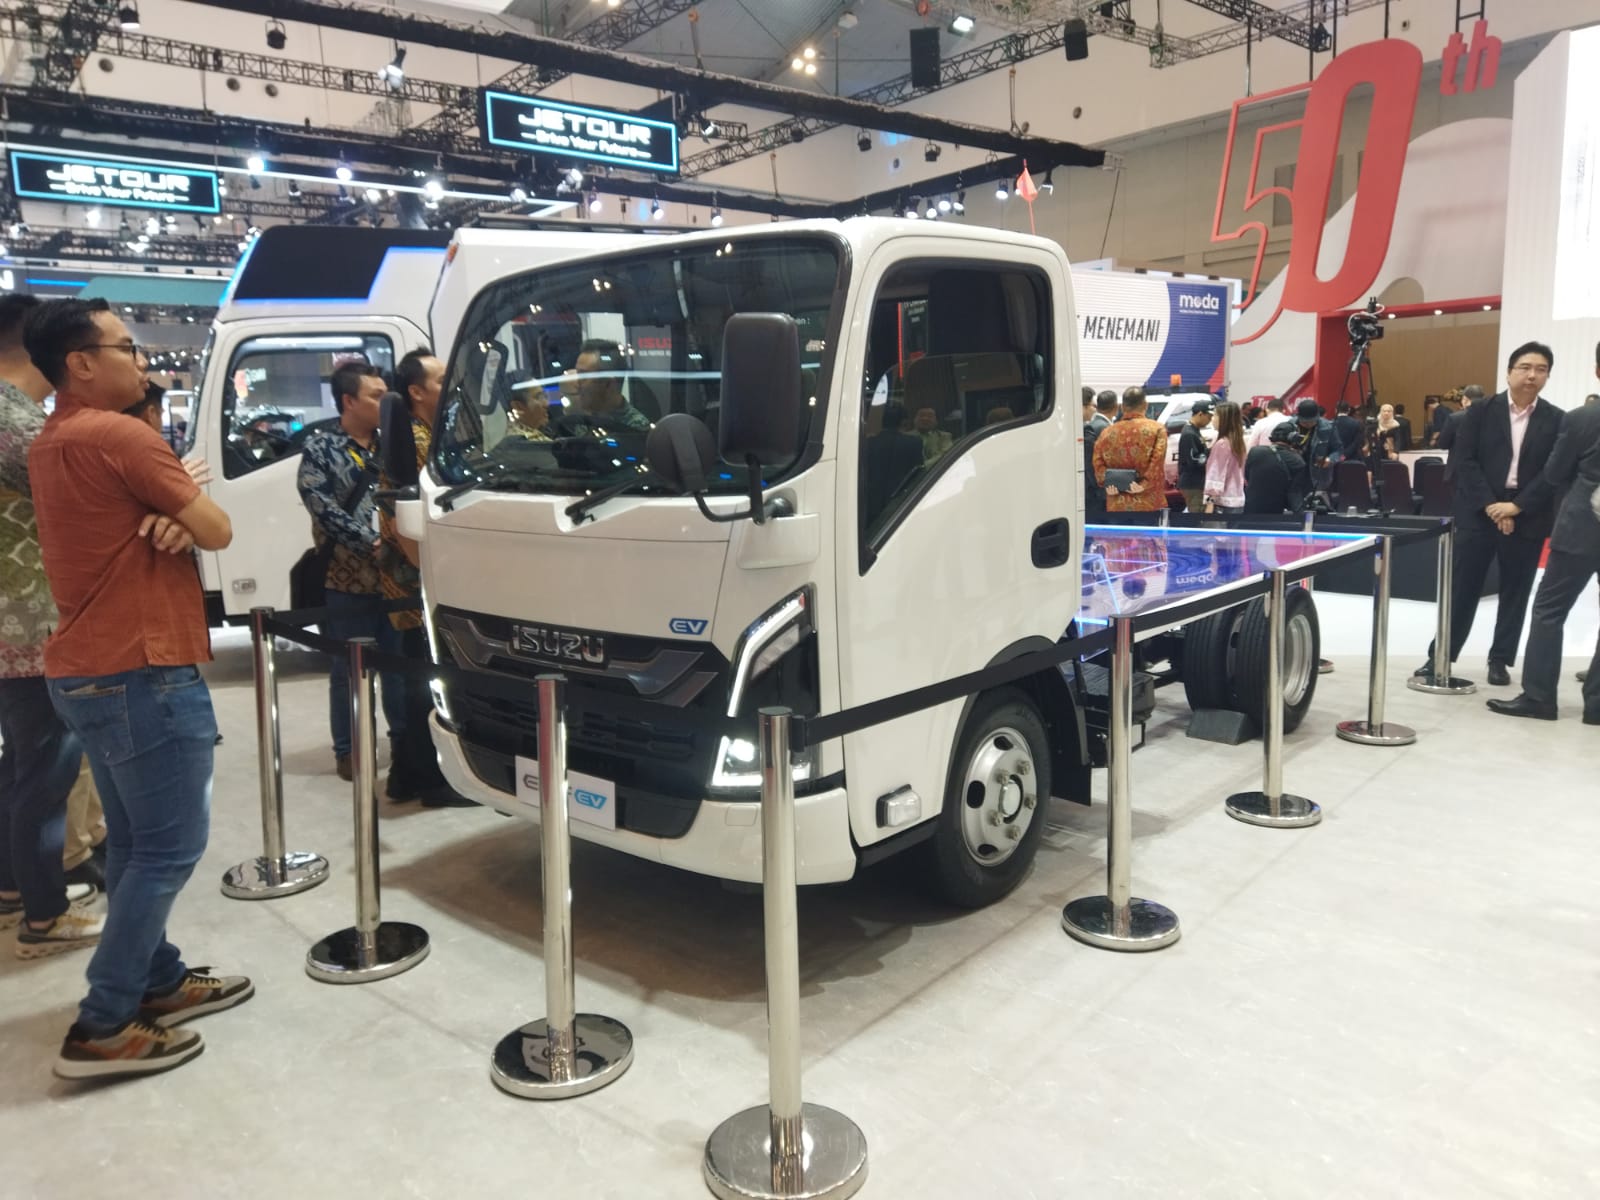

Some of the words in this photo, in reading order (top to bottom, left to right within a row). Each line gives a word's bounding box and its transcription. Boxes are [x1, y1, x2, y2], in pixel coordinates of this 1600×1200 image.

[518, 107, 652, 145] JETOUR
[535, 129, 570, 147] Drive
[46, 164, 190, 192] JETOUR
[1179, 293, 1219, 310] moda
[1083, 315, 1161, 342] MENEMANI
[638, 336, 672, 349] ISU
[672, 618, 705, 635] EV
[512, 624, 605, 664] ISUZU
[576, 791, 604, 808] EV
